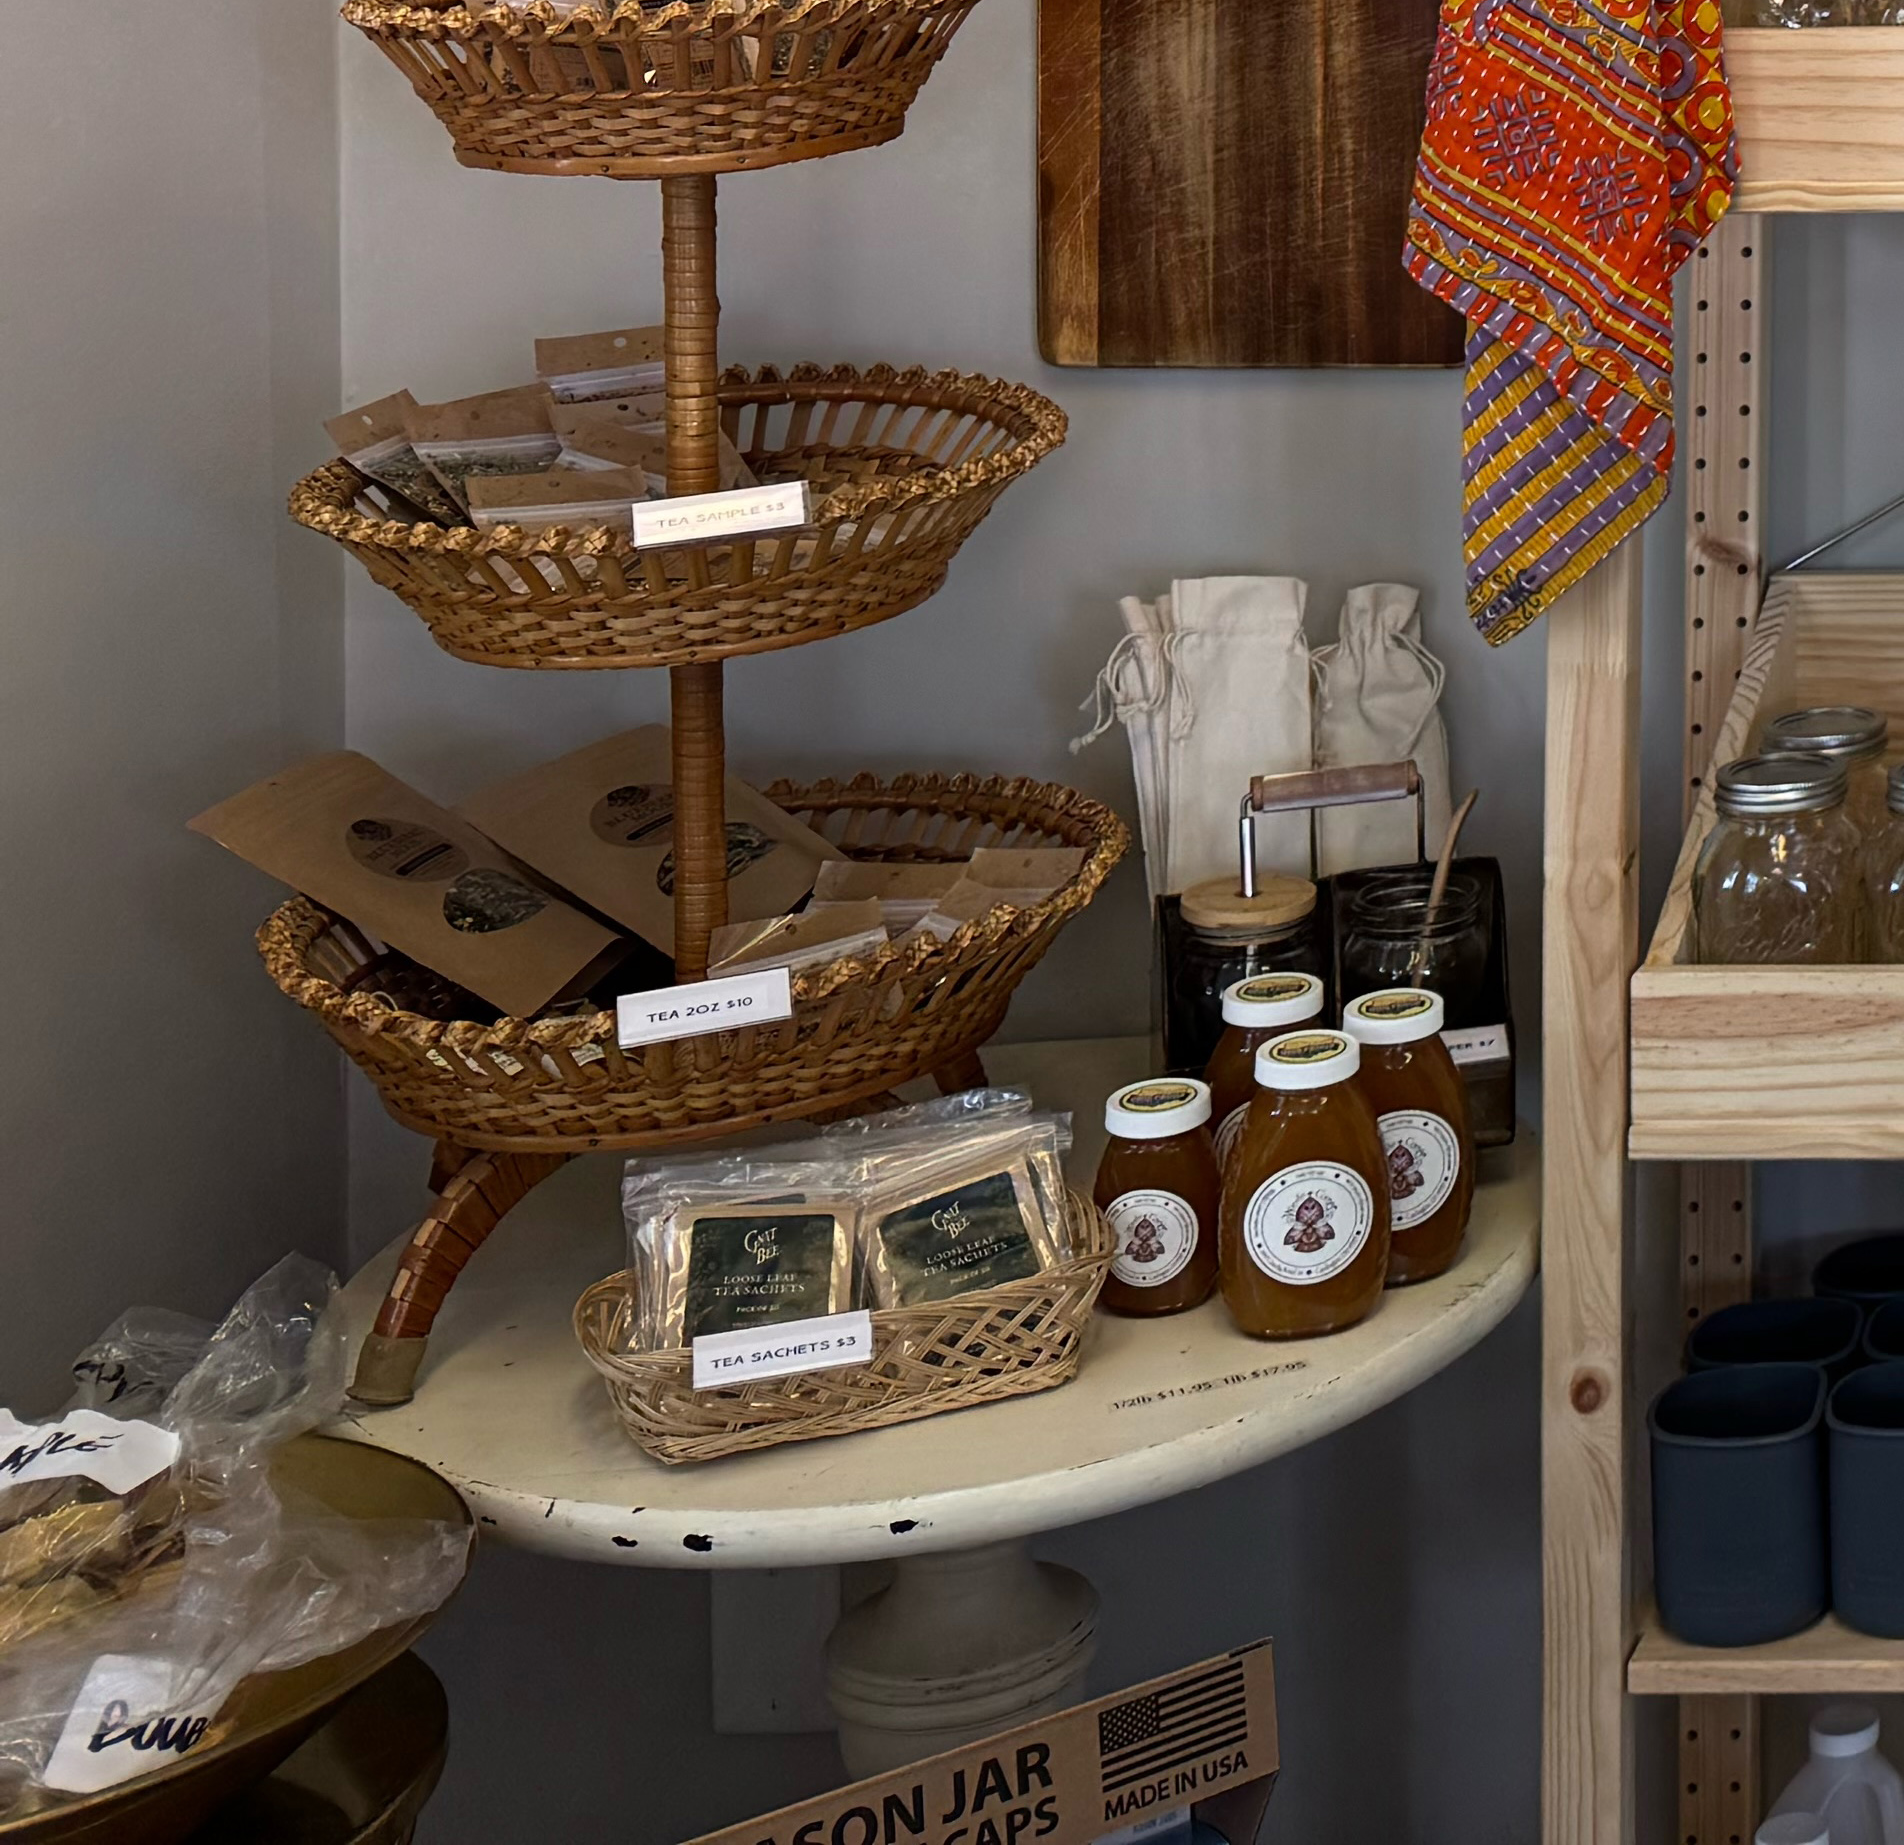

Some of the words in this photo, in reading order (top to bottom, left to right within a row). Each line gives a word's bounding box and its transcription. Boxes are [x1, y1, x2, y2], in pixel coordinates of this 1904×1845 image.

[656, 516, 689, 529] TEA
[696, 505, 760, 523] SAMPLE
[646, 1011, 680, 1023] TEA
[685, 1002, 720, 1017] 2OZ
[727, 996, 753, 1009] $10
[923, 1263, 948, 1277] TEA
[950, 1242, 1009, 1267] SACHETS
[926, 1245, 964, 1265] LOOSE
[966, 1236, 995, 1250] LEAF
[714, 1287, 741, 1296] TEA
[743, 1284, 805, 1296] SACHETS
[723, 1274, 763, 1285] LOOSE
[766, 1273, 798, 1284] LEAF
[711, 1357, 744, 1369] TEA
[751, 1340, 831, 1364] SACHETS
[836, 1336, 857, 1348] $3
[1113, 1395, 1152, 1410] 1/2lb
[941, 1742, 1055, 1823] JAR
[1103, 1780, 1171, 1822] MADE
[1173, 1765, 1199, 1795] IN
[1202, 1750, 1250, 1783] USA
